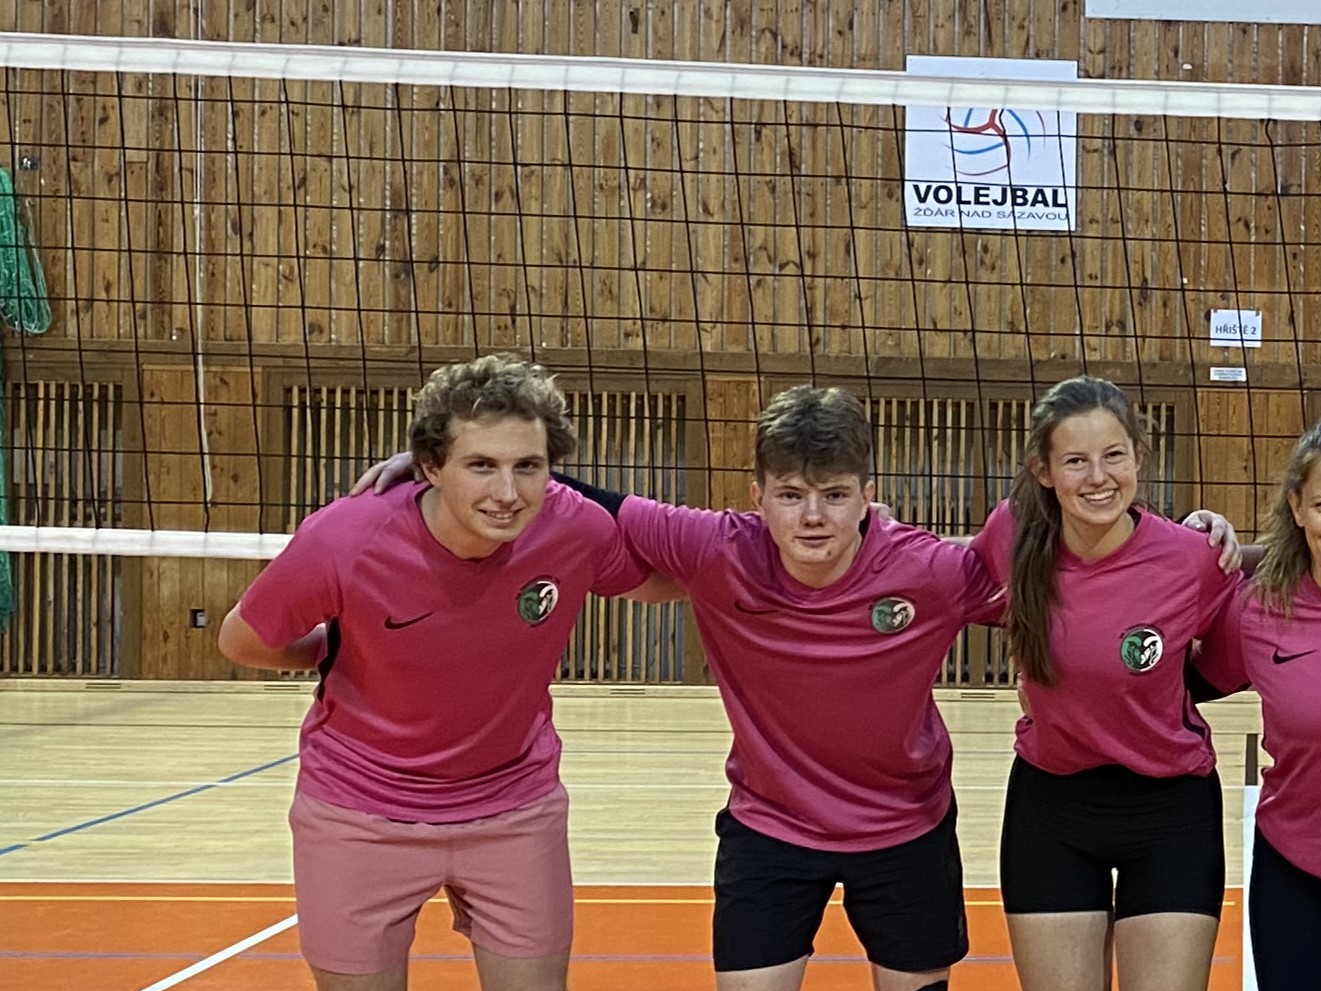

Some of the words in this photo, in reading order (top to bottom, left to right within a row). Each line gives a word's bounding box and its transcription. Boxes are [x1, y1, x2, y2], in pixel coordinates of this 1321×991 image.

[912, 184, 1068, 208] VOLEJBAL
[960, 209, 992, 219] NAD
[1250, 326, 1257, 335] 2
